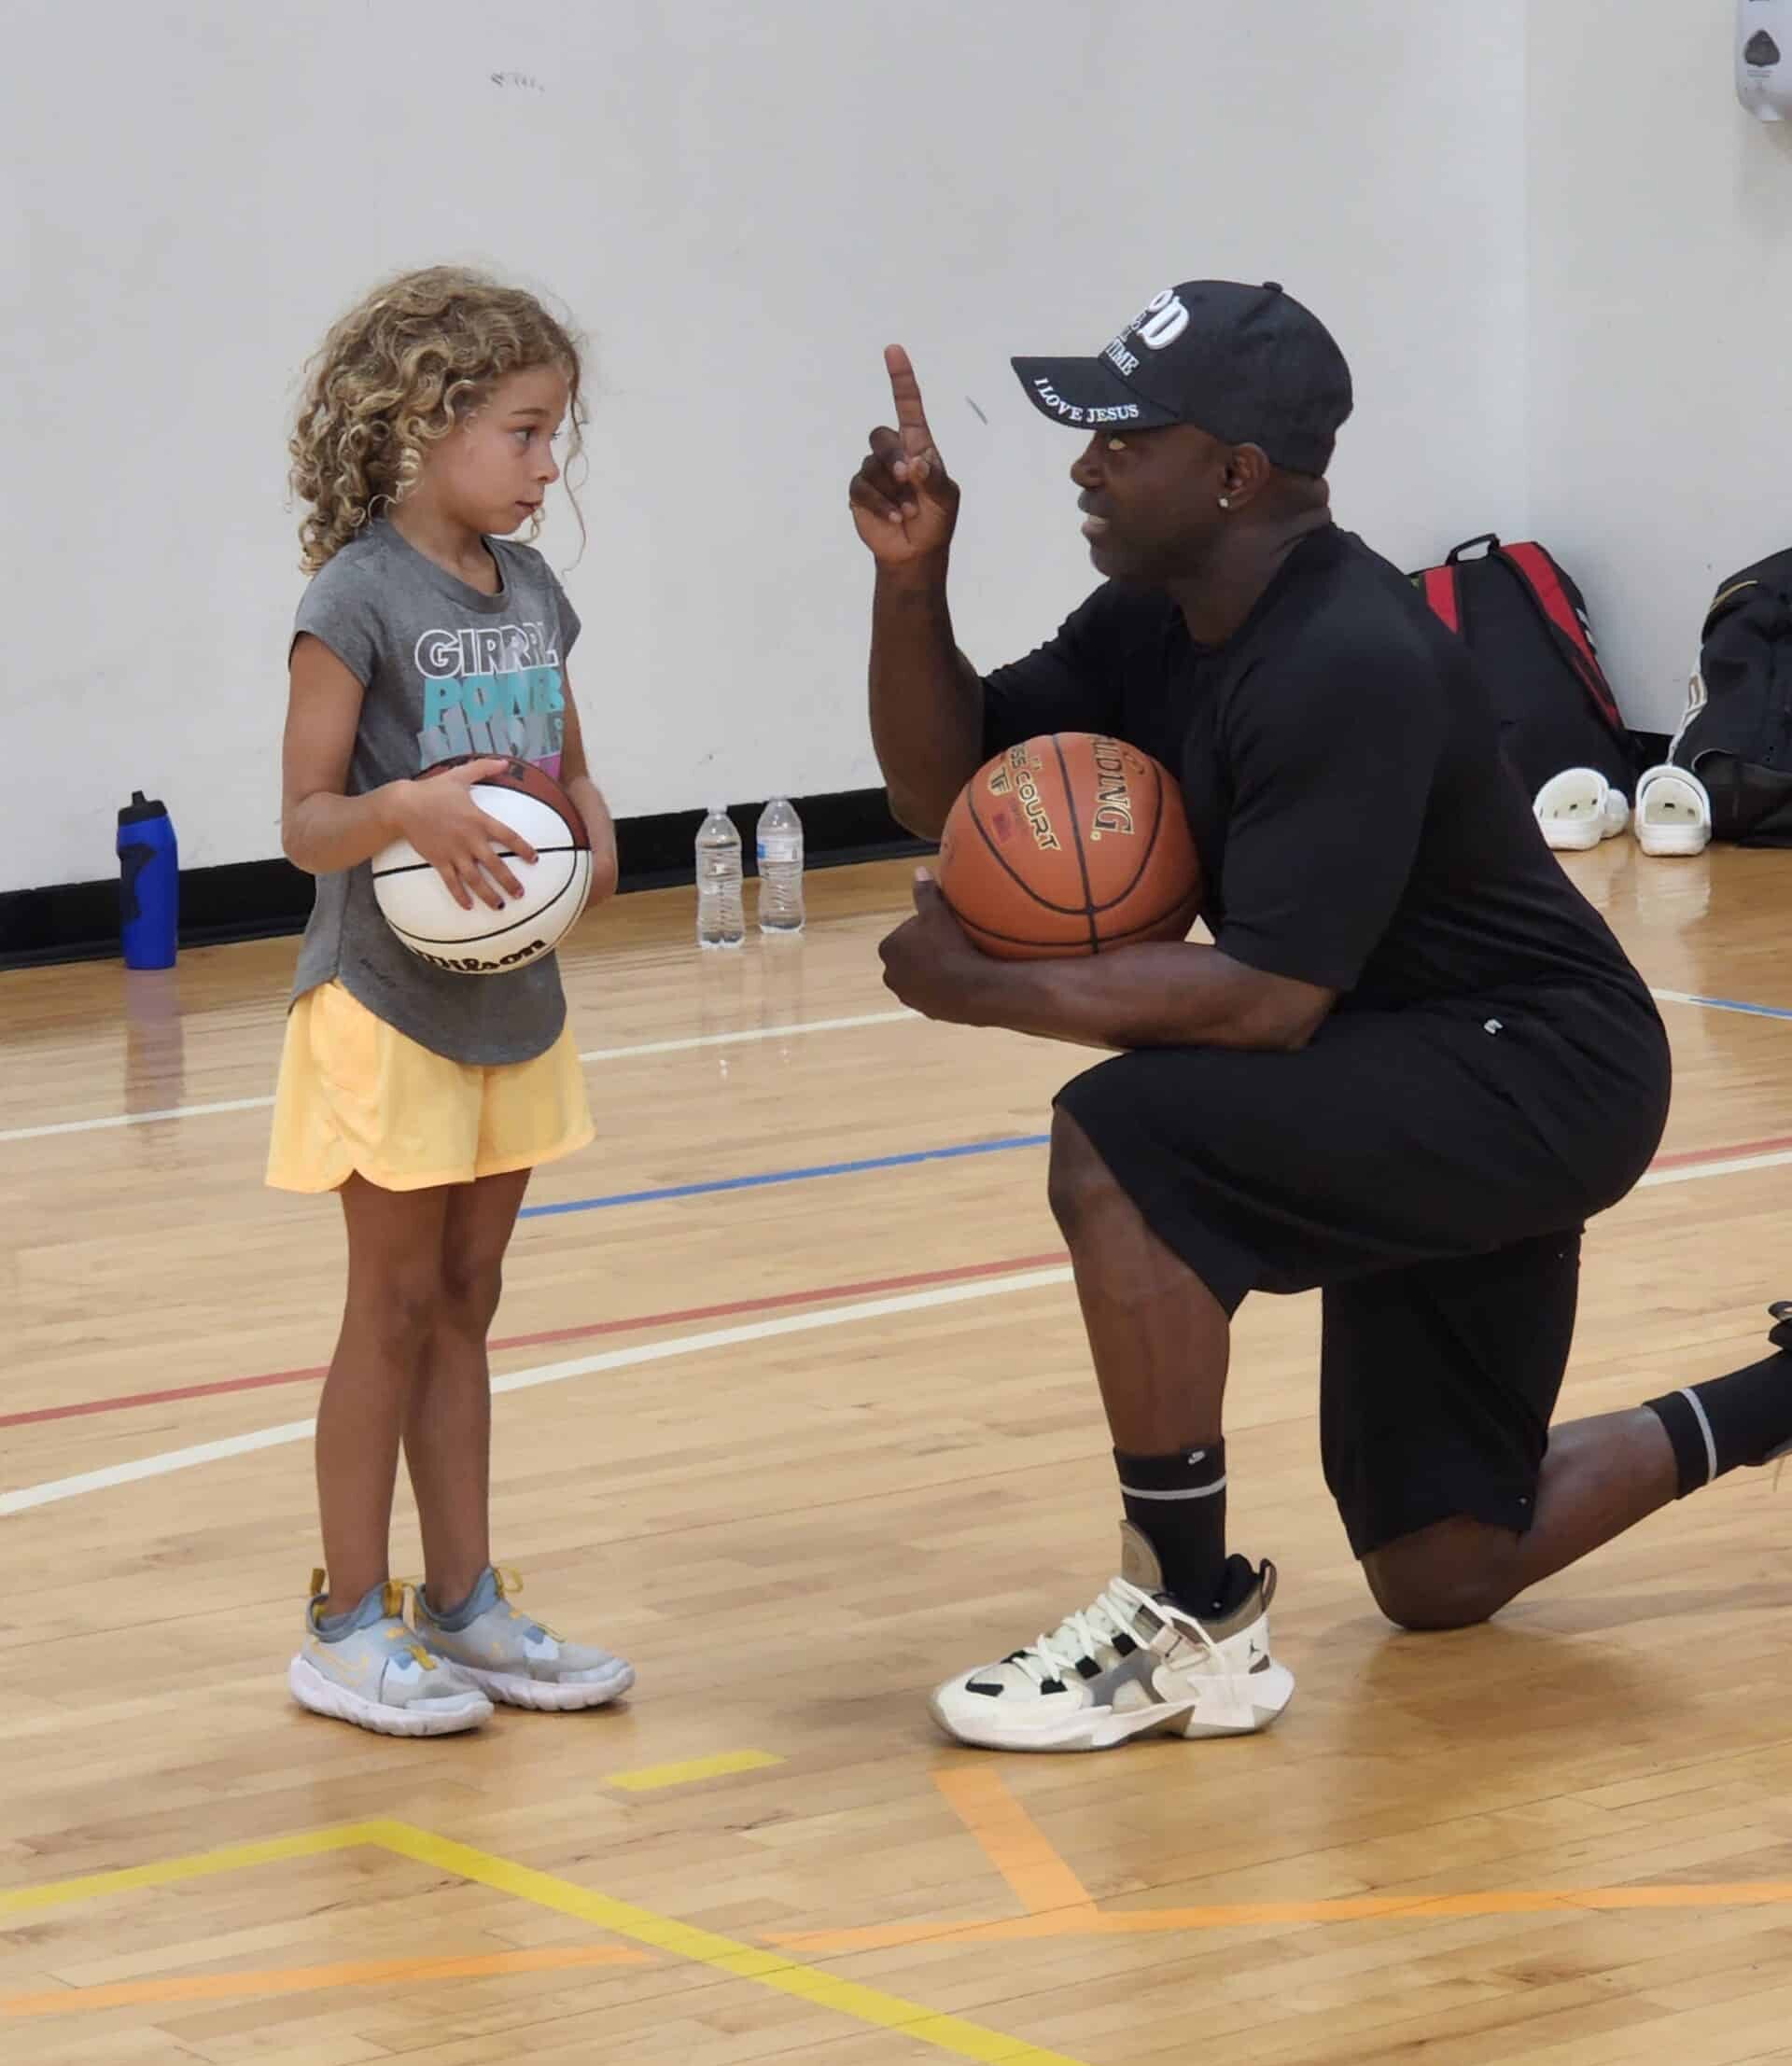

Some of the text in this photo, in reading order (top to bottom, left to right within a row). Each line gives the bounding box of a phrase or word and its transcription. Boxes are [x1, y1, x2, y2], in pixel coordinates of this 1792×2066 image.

[1136, 288, 1190, 350] OD
[1033, 378, 1140, 423] I LOVE JESUS
[1014, 771, 1061, 851] COURT
